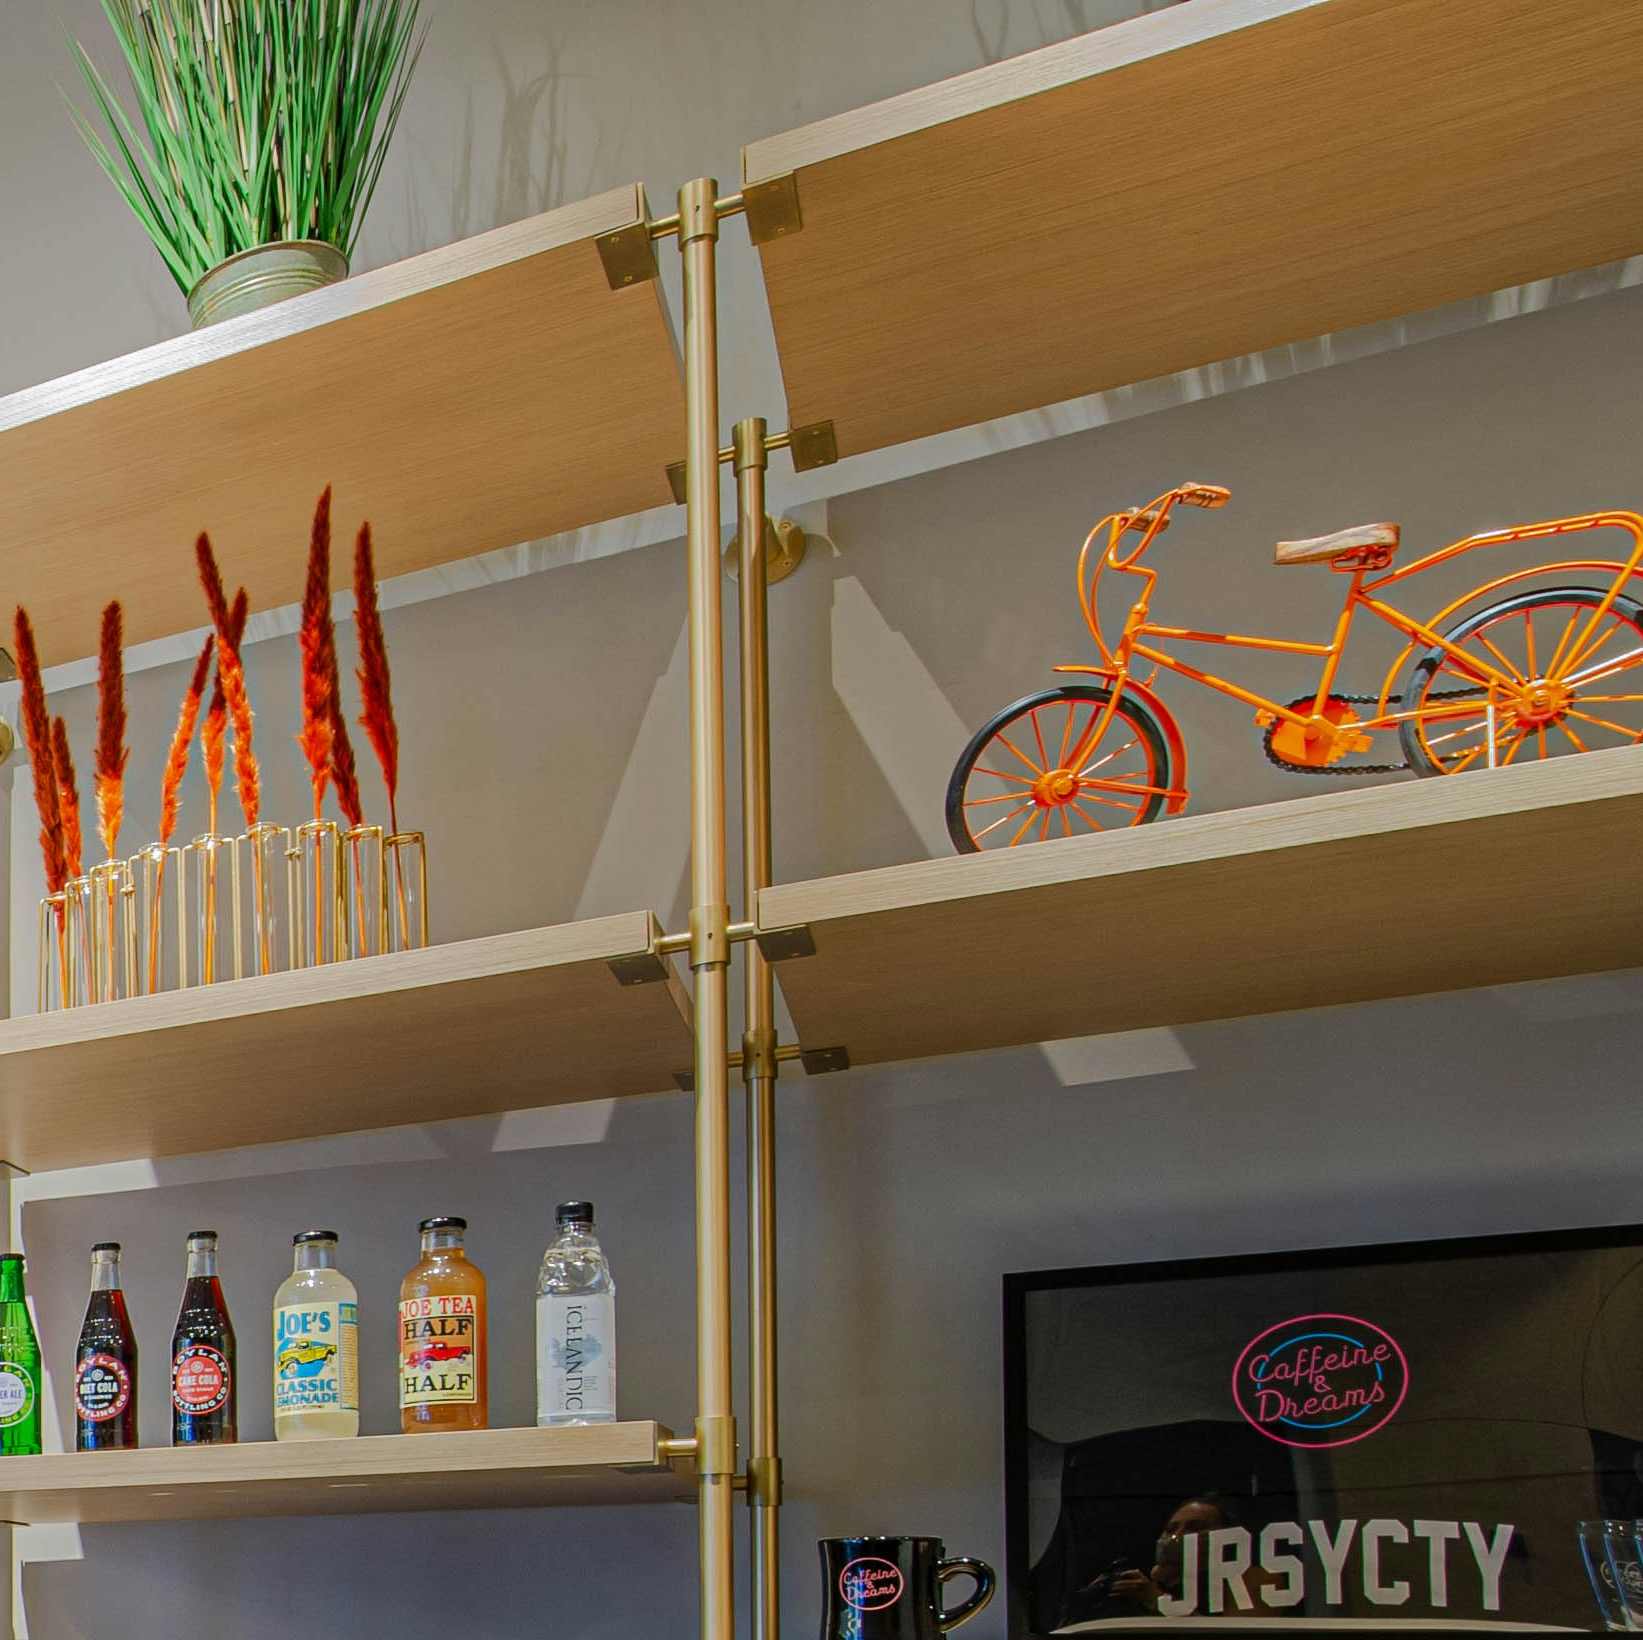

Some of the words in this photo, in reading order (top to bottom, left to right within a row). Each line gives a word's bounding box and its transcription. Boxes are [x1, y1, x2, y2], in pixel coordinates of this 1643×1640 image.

[403, 1298, 432, 1320] JOE
[438, 1296, 475, 1315] TEA
[276, 1311, 332, 1341] JOE'S
[404, 1318, 473, 1340] HALF
[565, 1304, 584, 1411] ICELANDIC
[1248, 1344, 1392, 1387] Caffeine
[96, 1381, 118, 1393] COLA
[198, 1373, 219, 1385] COLA
[404, 1373, 473, 1395] HALF
[1313, 1375, 1332, 1393] &
[10, 1389, 22, 1399] ALE
[1254, 1380, 1386, 1423] Dreams
[843, 1568, 898, 1585] Caffeine
[1158, 1519, 1515, 1617] JRSYCTY
